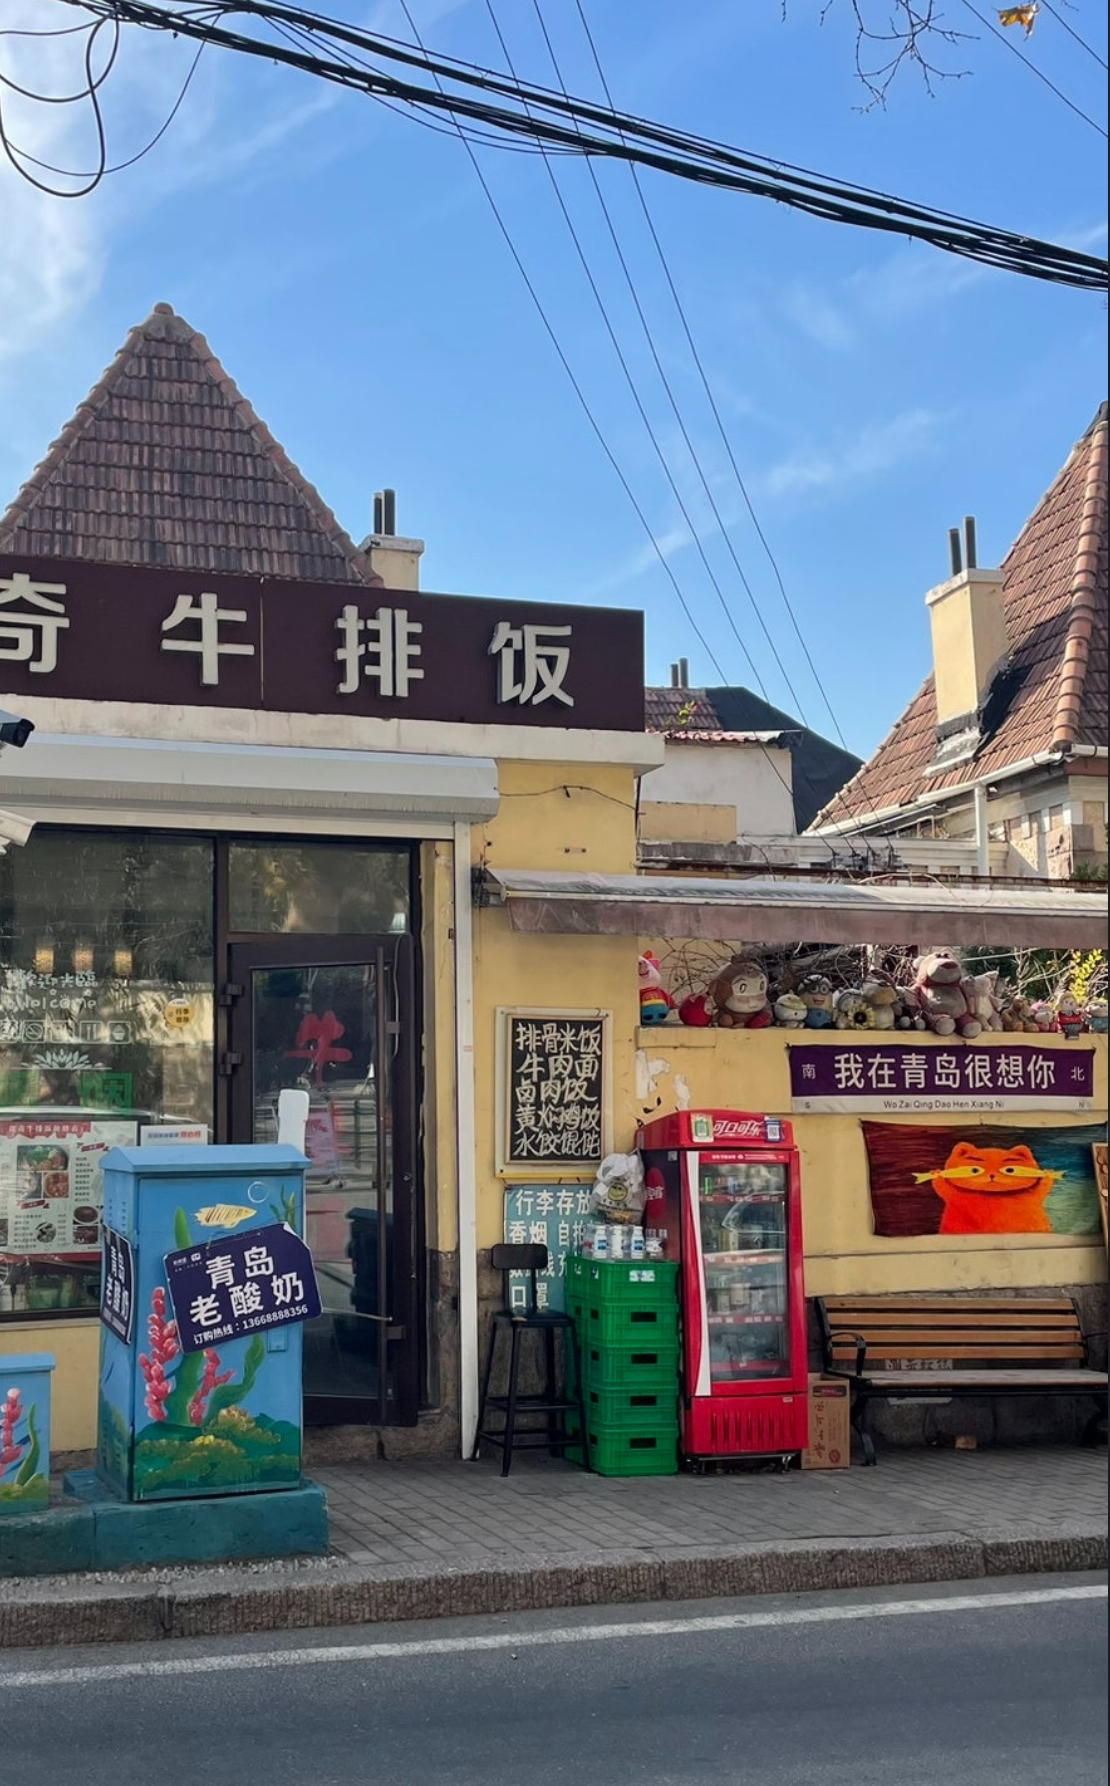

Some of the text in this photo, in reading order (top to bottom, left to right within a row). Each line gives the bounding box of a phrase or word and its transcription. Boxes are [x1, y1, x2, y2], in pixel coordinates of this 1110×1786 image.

[515, 1022, 602, 1056] 排骨米饭
[515, 1051, 599, 1082] 牛肉面
[801, 1053, 1085, 1090] 南 我在青岛很想你 北
[515, 1076, 598, 1104] 卤肉饭
[884, 1100, 897, 1109] Wo
[899, 1100, 912, 1109] Zai
[913, 1100, 933, 1112] Qing
[934, 1100, 951, 1109] Dao
[953, 1100, 969, 1109] Hen
[971, 1100, 995, 1112] Xiang
[996, 1100, 1004, 1109] Ni
[512, 1130, 600, 1157] 水饺馄饨
[714, 1120, 762, 1137] 可口可乐
[205, 1246, 274, 1290] 青岛
[189, 1271, 305, 1327] 老酸奶
